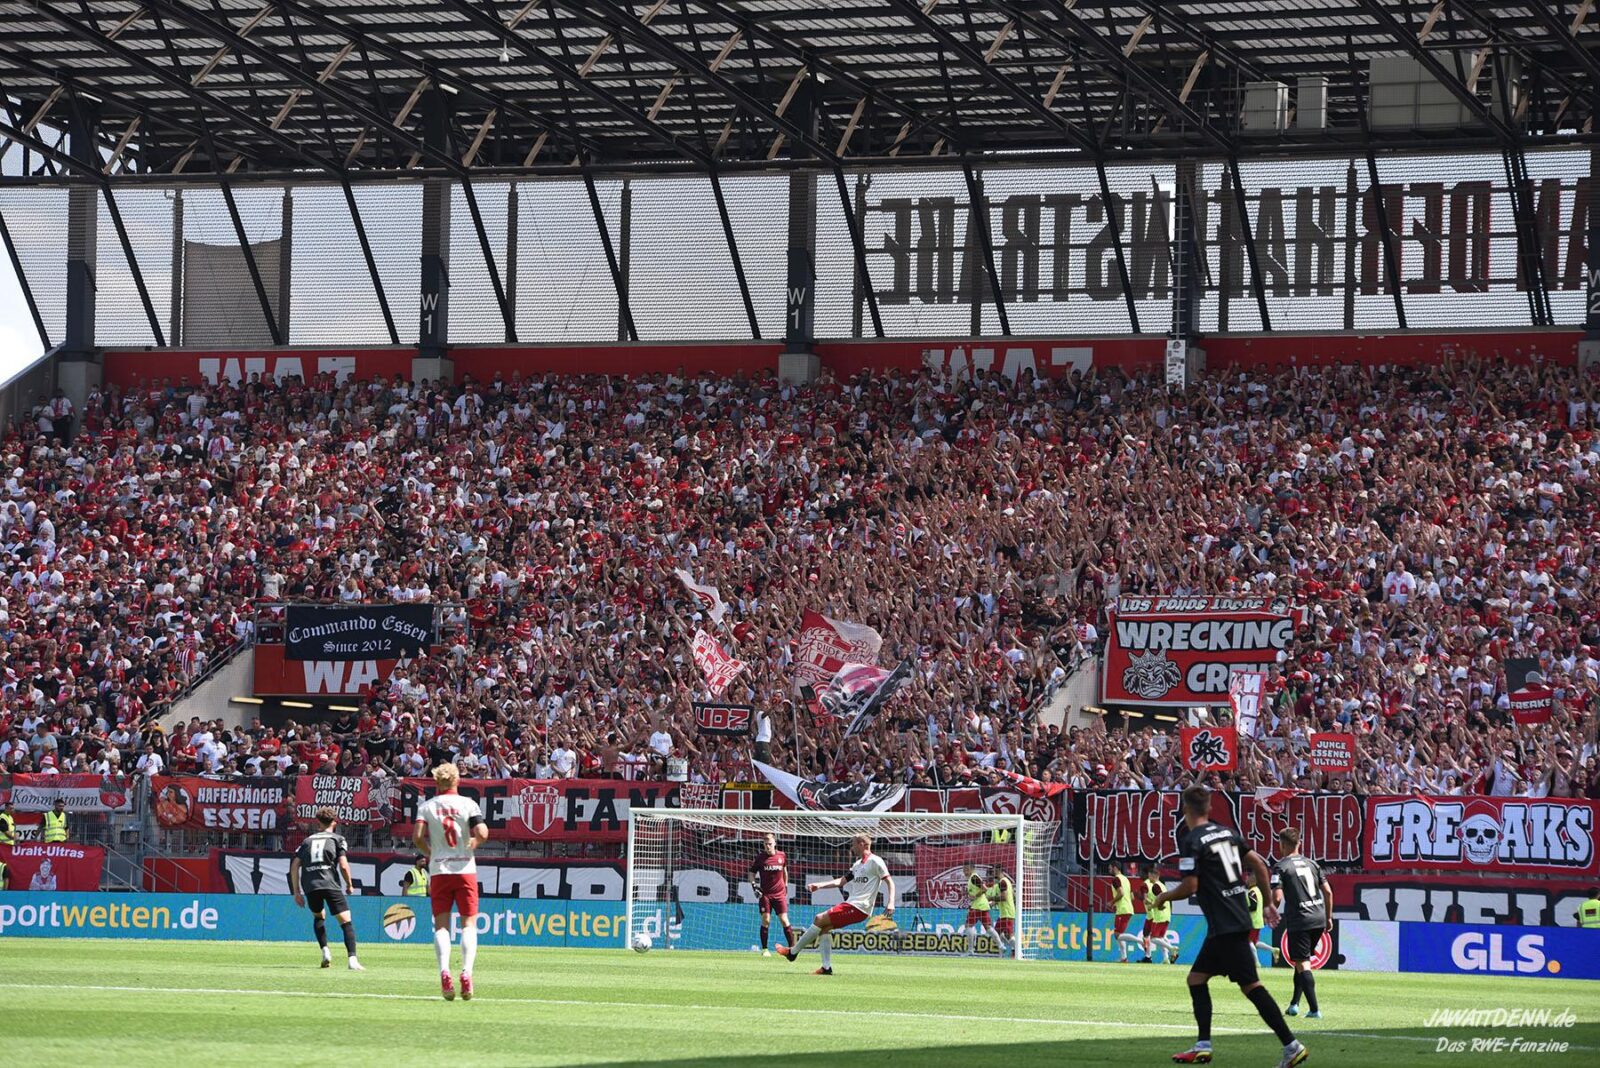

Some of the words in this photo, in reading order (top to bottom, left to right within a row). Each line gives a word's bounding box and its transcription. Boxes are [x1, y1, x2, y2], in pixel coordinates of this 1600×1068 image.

[421, 293, 439, 310] W
[787, 287, 806, 305] W
[424, 314, 432, 334] 1
[791, 308, 799, 329] 1
[288, 616, 377, 643] Commando
[381, 615, 428, 642] Essen
[1116, 619, 1294, 650] WRECKING
[323, 640, 359, 653] Since
[361, 638, 392, 652] 2012
[1316, 740, 1346, 750] JUNGE
[1311, 749, 1351, 759] ESSENER
[1313, 757, 1348, 767] ULTRAS
[312, 776, 338, 790] EHRE
[340, 776, 362, 792] DER
[315, 790, 354, 806] GRUPPE
[1078, 792, 1182, 862] JUNGE
[1371, 799, 1595, 868] FREAKS
[11, 845, 85, 859] Uralt-Ultras
[1296, 867, 1317, 898] 7
